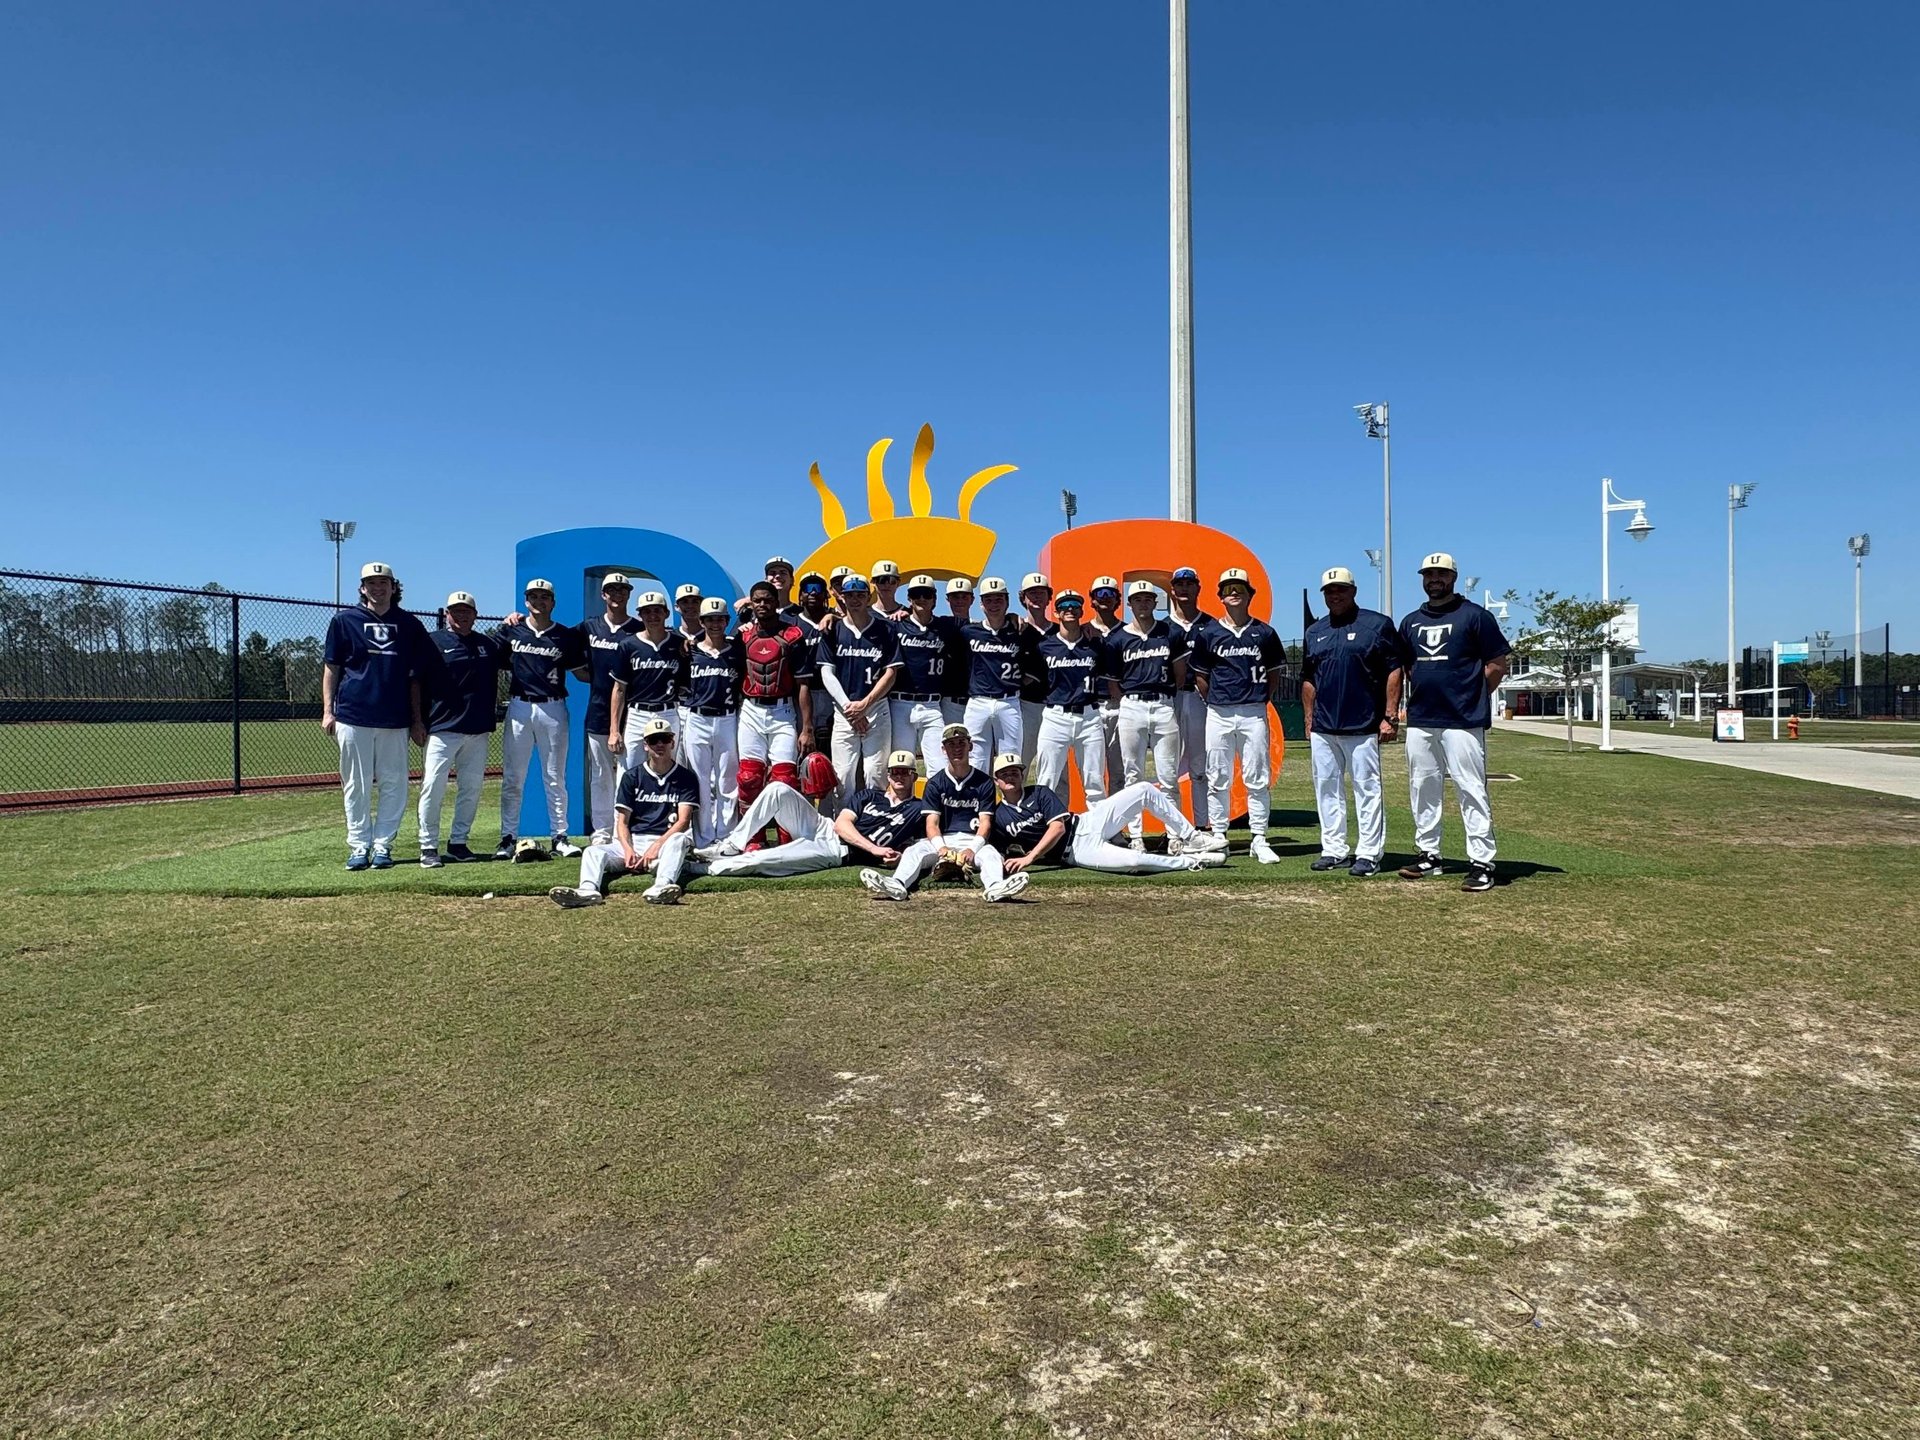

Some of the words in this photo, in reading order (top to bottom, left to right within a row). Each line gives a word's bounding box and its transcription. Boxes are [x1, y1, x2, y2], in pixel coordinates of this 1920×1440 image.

[1431, 556, 1441, 564] U
[374, 565, 382, 573] U
[1328, 571, 1338, 580] U
[990, 580, 998, 589] U
[711, 601, 720, 610] U
[588, 634, 619, 650] Univer
[897, 632, 944, 653] University
[970, 639, 1020, 658] University
[510, 639, 563, 662] University
[836, 644, 882, 662] University
[1122, 645, 1170, 663] University
[1214, 644, 1262, 662] University
[630, 658, 680, 674] University
[928, 658, 944, 675] 18
[1001, 662, 1022, 680] 22
[1046, 656, 1096, 671] University
[1250, 666, 1268, 684] 12
[655, 722, 664, 730] U
[897, 754, 906, 762] U
[868, 826, 892, 846] 10
